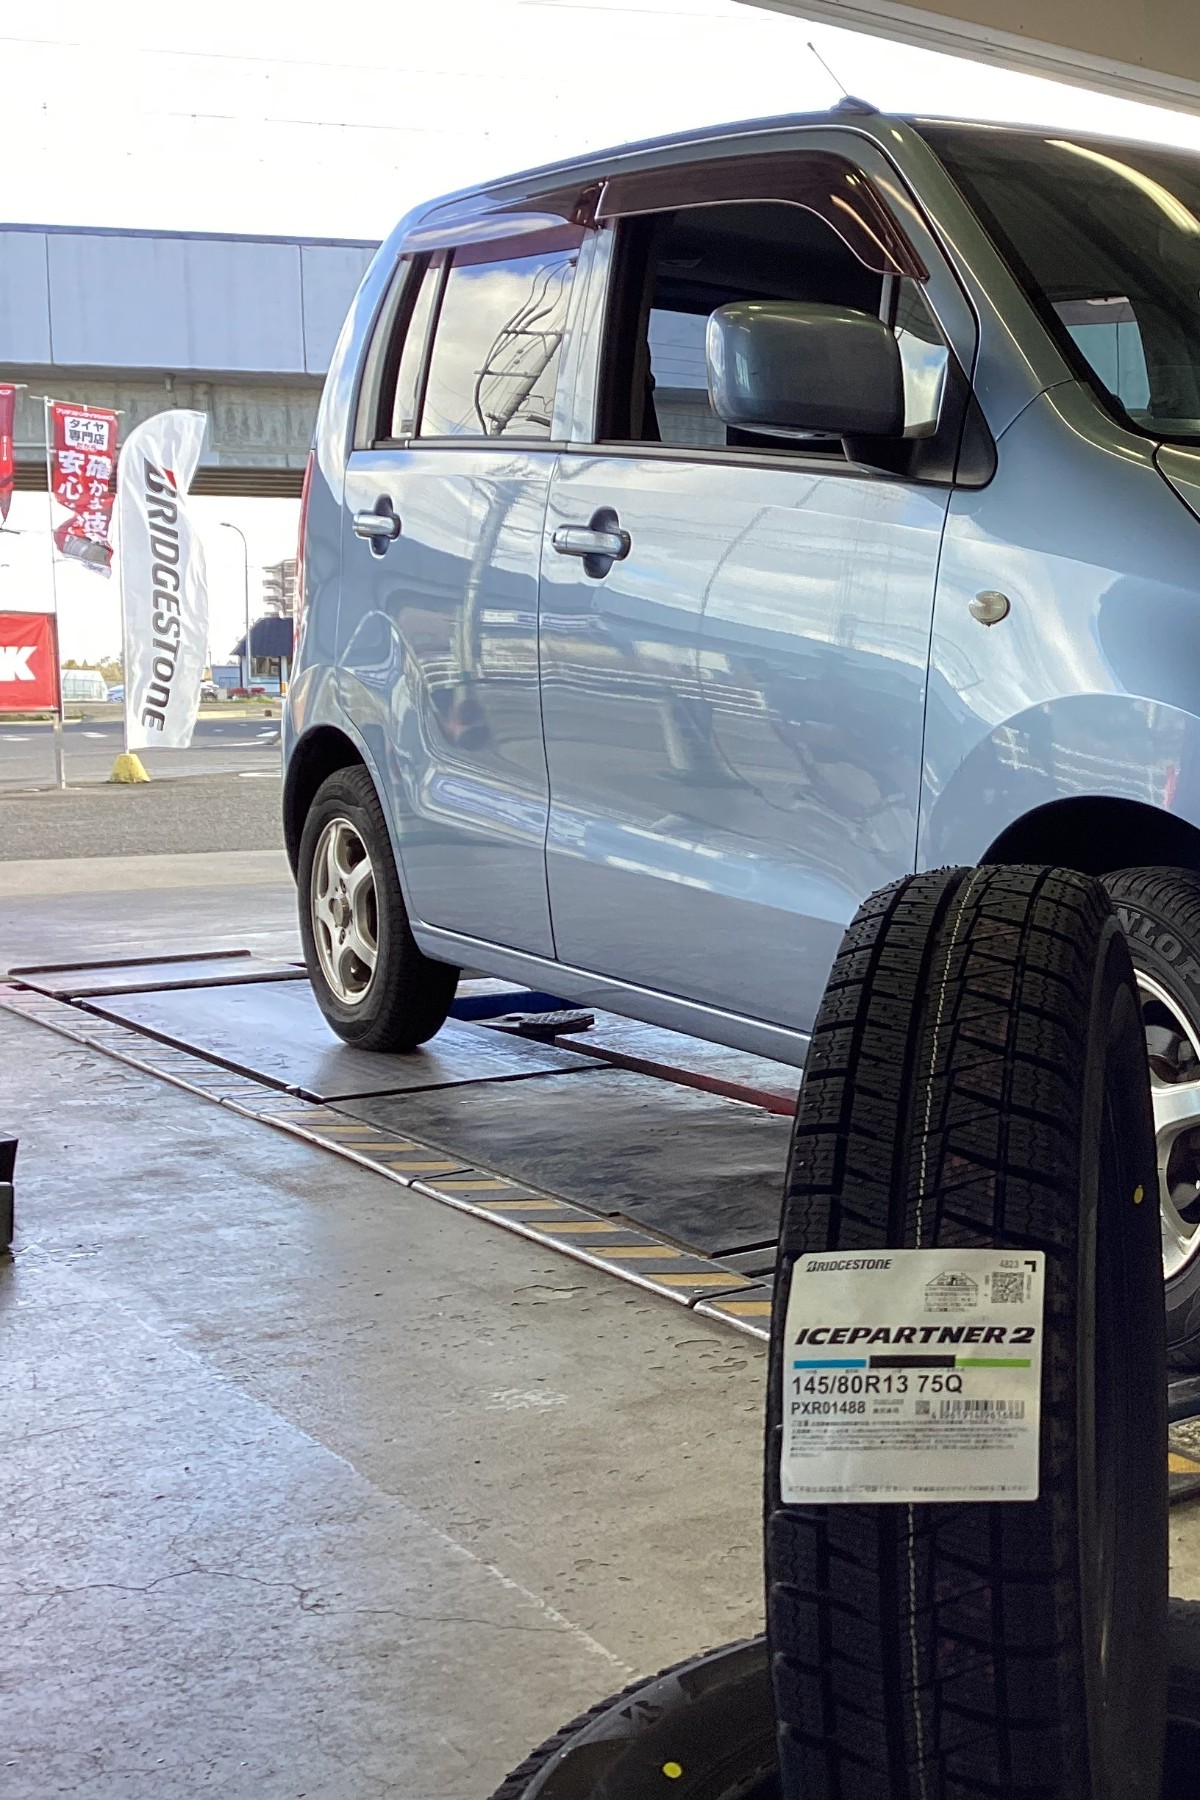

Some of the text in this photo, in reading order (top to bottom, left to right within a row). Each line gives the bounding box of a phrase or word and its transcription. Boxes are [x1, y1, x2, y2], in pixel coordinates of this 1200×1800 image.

[69, 418, 104, 432] タイヤ
[69, 429, 105, 446] 専門店
[142, 457, 181, 732] BRIDGESTONE
[806, 1258, 893, 1273] BRIDGESTONE
[791, 1373, 963, 1396] 145/80R13 75Q
[791, 1400, 866, 1415] PXR01488
